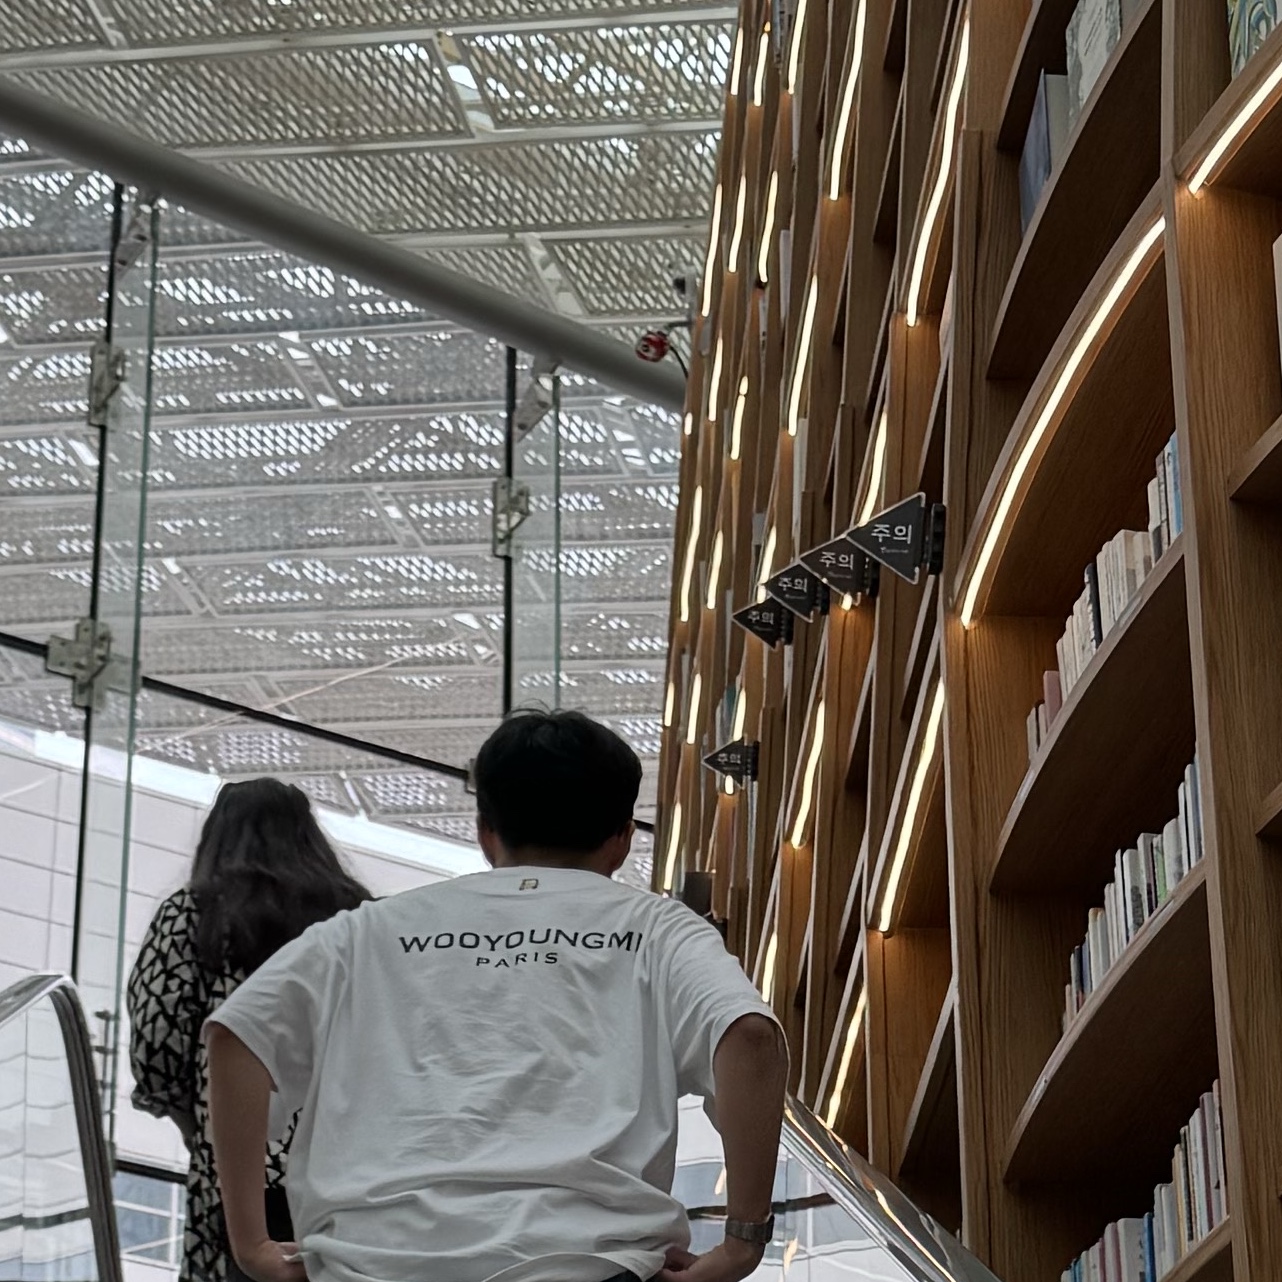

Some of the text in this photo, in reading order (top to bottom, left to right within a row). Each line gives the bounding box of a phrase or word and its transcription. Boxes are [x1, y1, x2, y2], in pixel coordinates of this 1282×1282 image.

[870, 523, 913, 545] 주의
[819, 551, 854, 571] 주의
[778, 577, 808, 593] 주의
[748, 610, 774, 626] 주의
[398, 928, 643, 954] WOOYOUNGMI
[475, 951, 559, 968] PARIS
